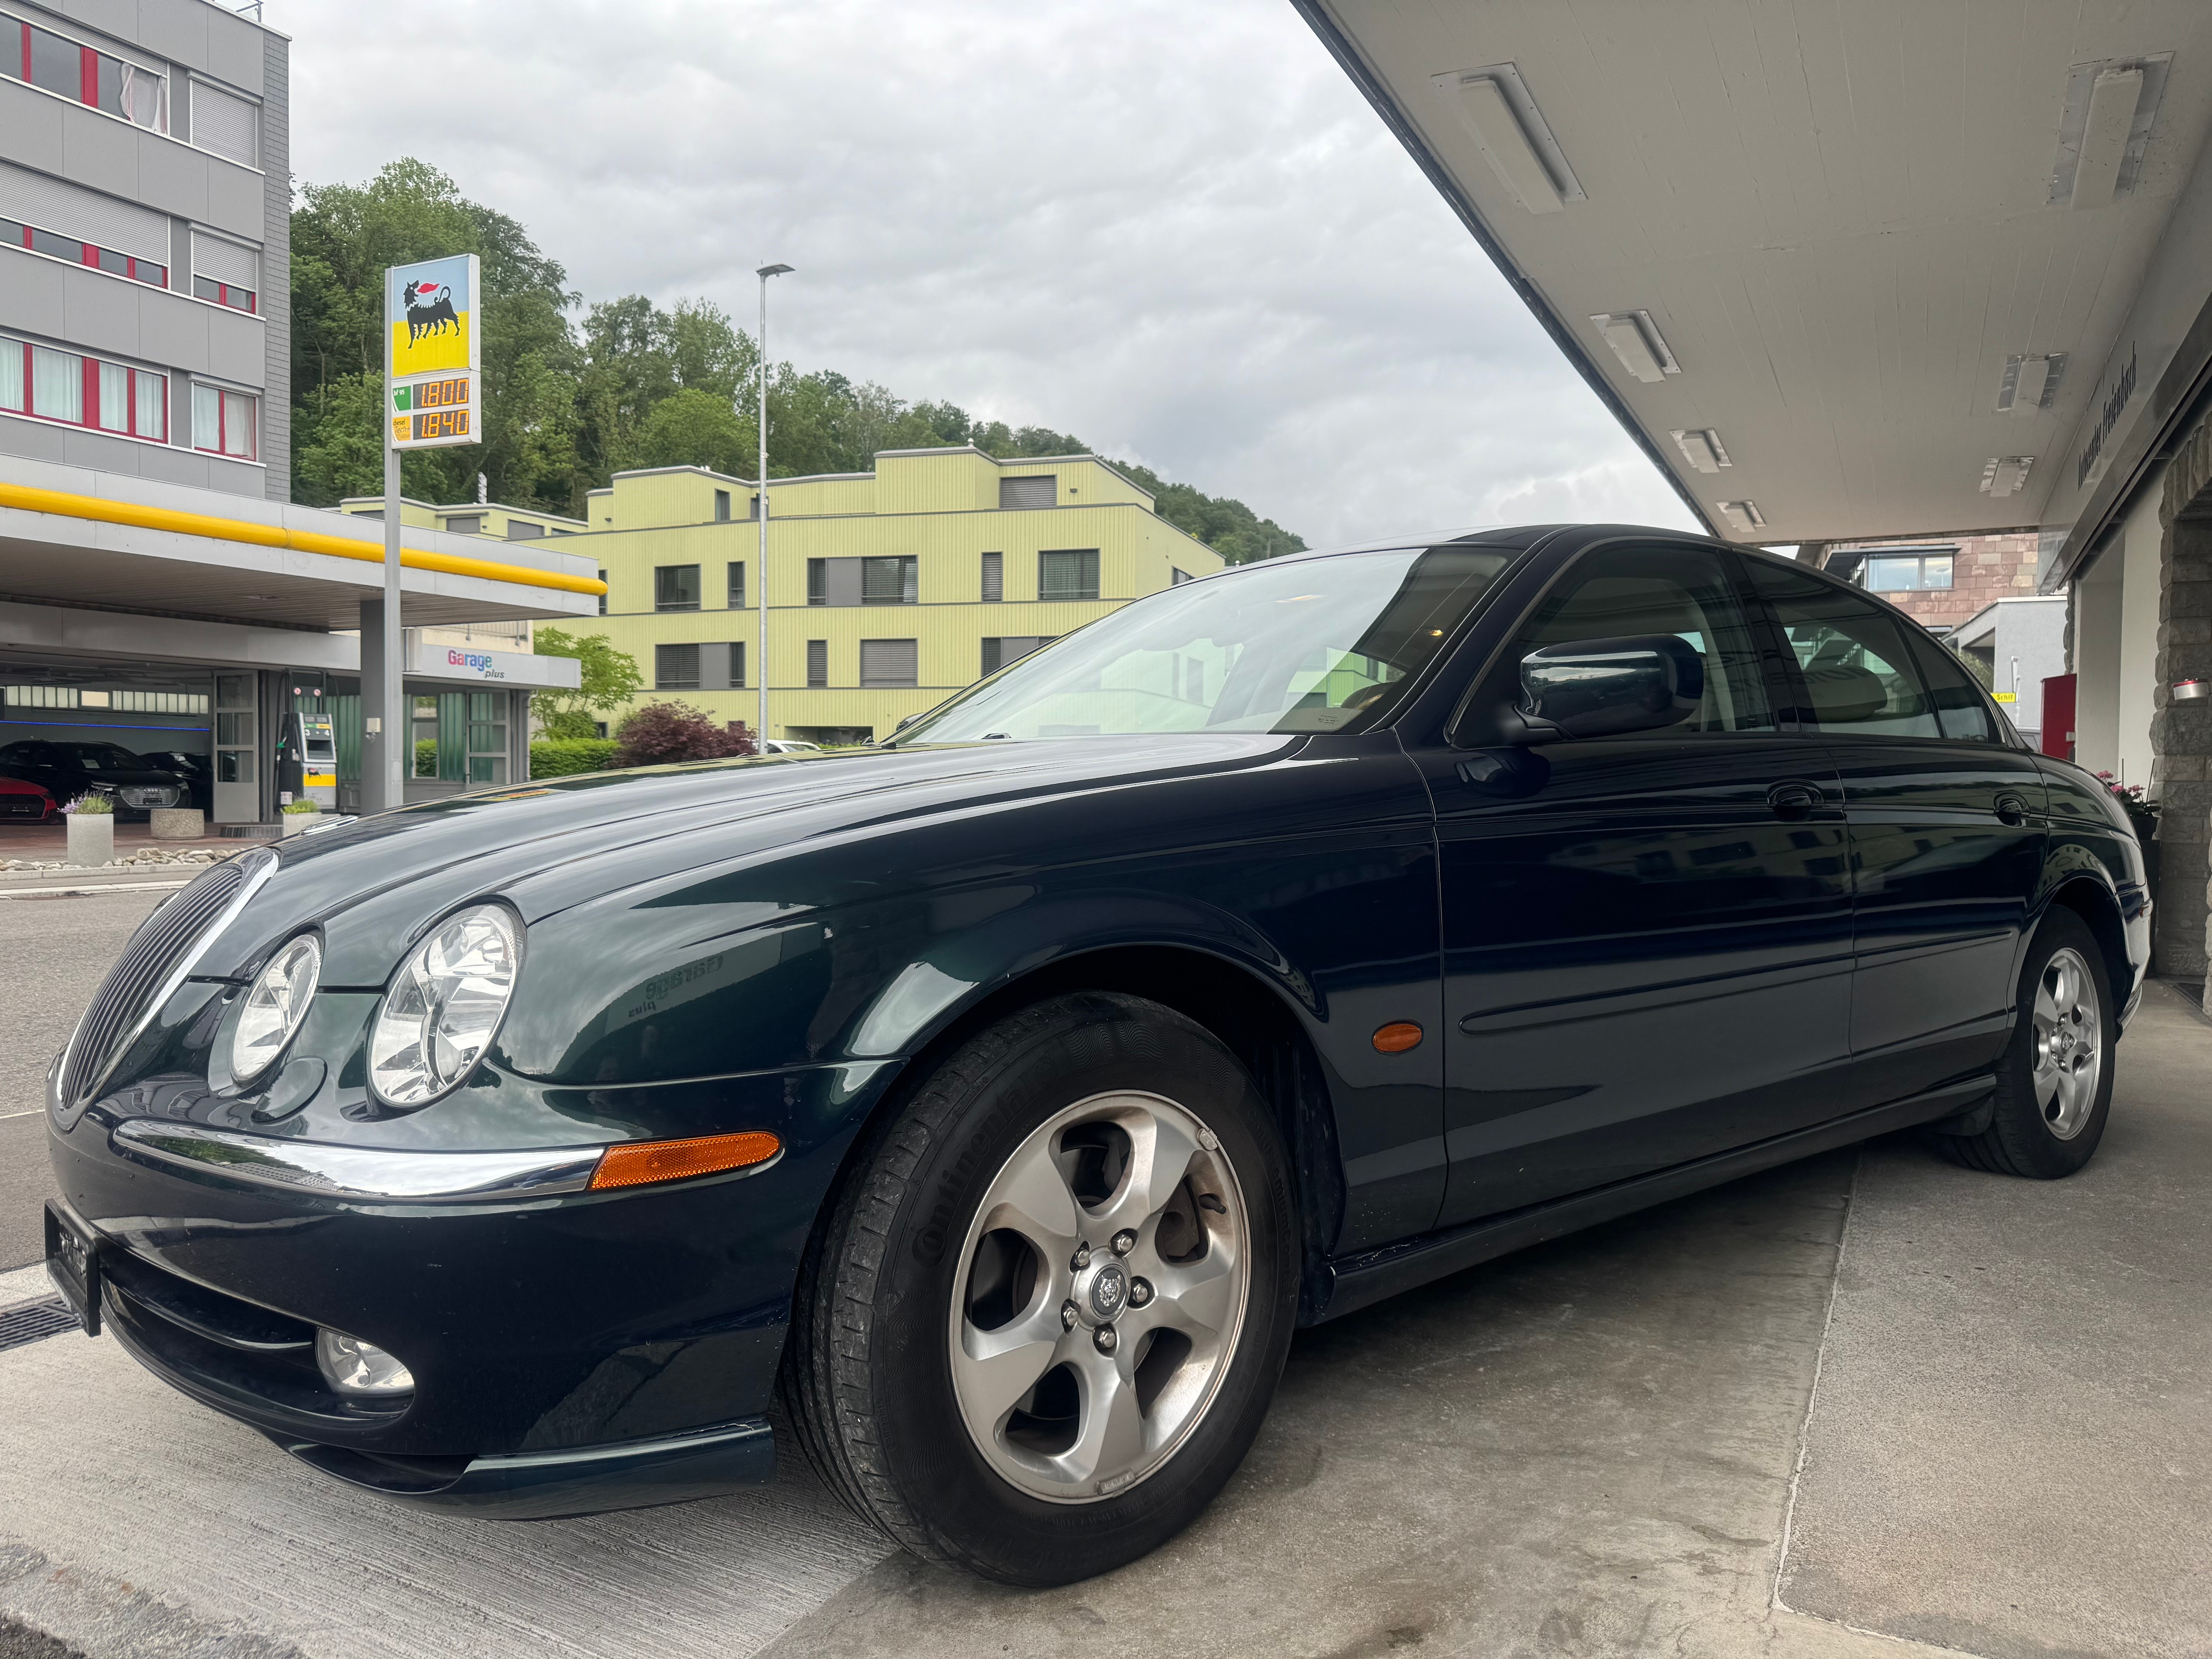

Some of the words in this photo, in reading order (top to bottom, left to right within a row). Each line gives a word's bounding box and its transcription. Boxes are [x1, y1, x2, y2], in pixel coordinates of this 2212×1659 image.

[422, 378, 469, 407] 1.800
[422, 410, 469, 437] 1.840
[448, 650, 493, 672] Garage
[485, 669, 505, 678] plus
[912, 1076, 1039, 1269] Continental
